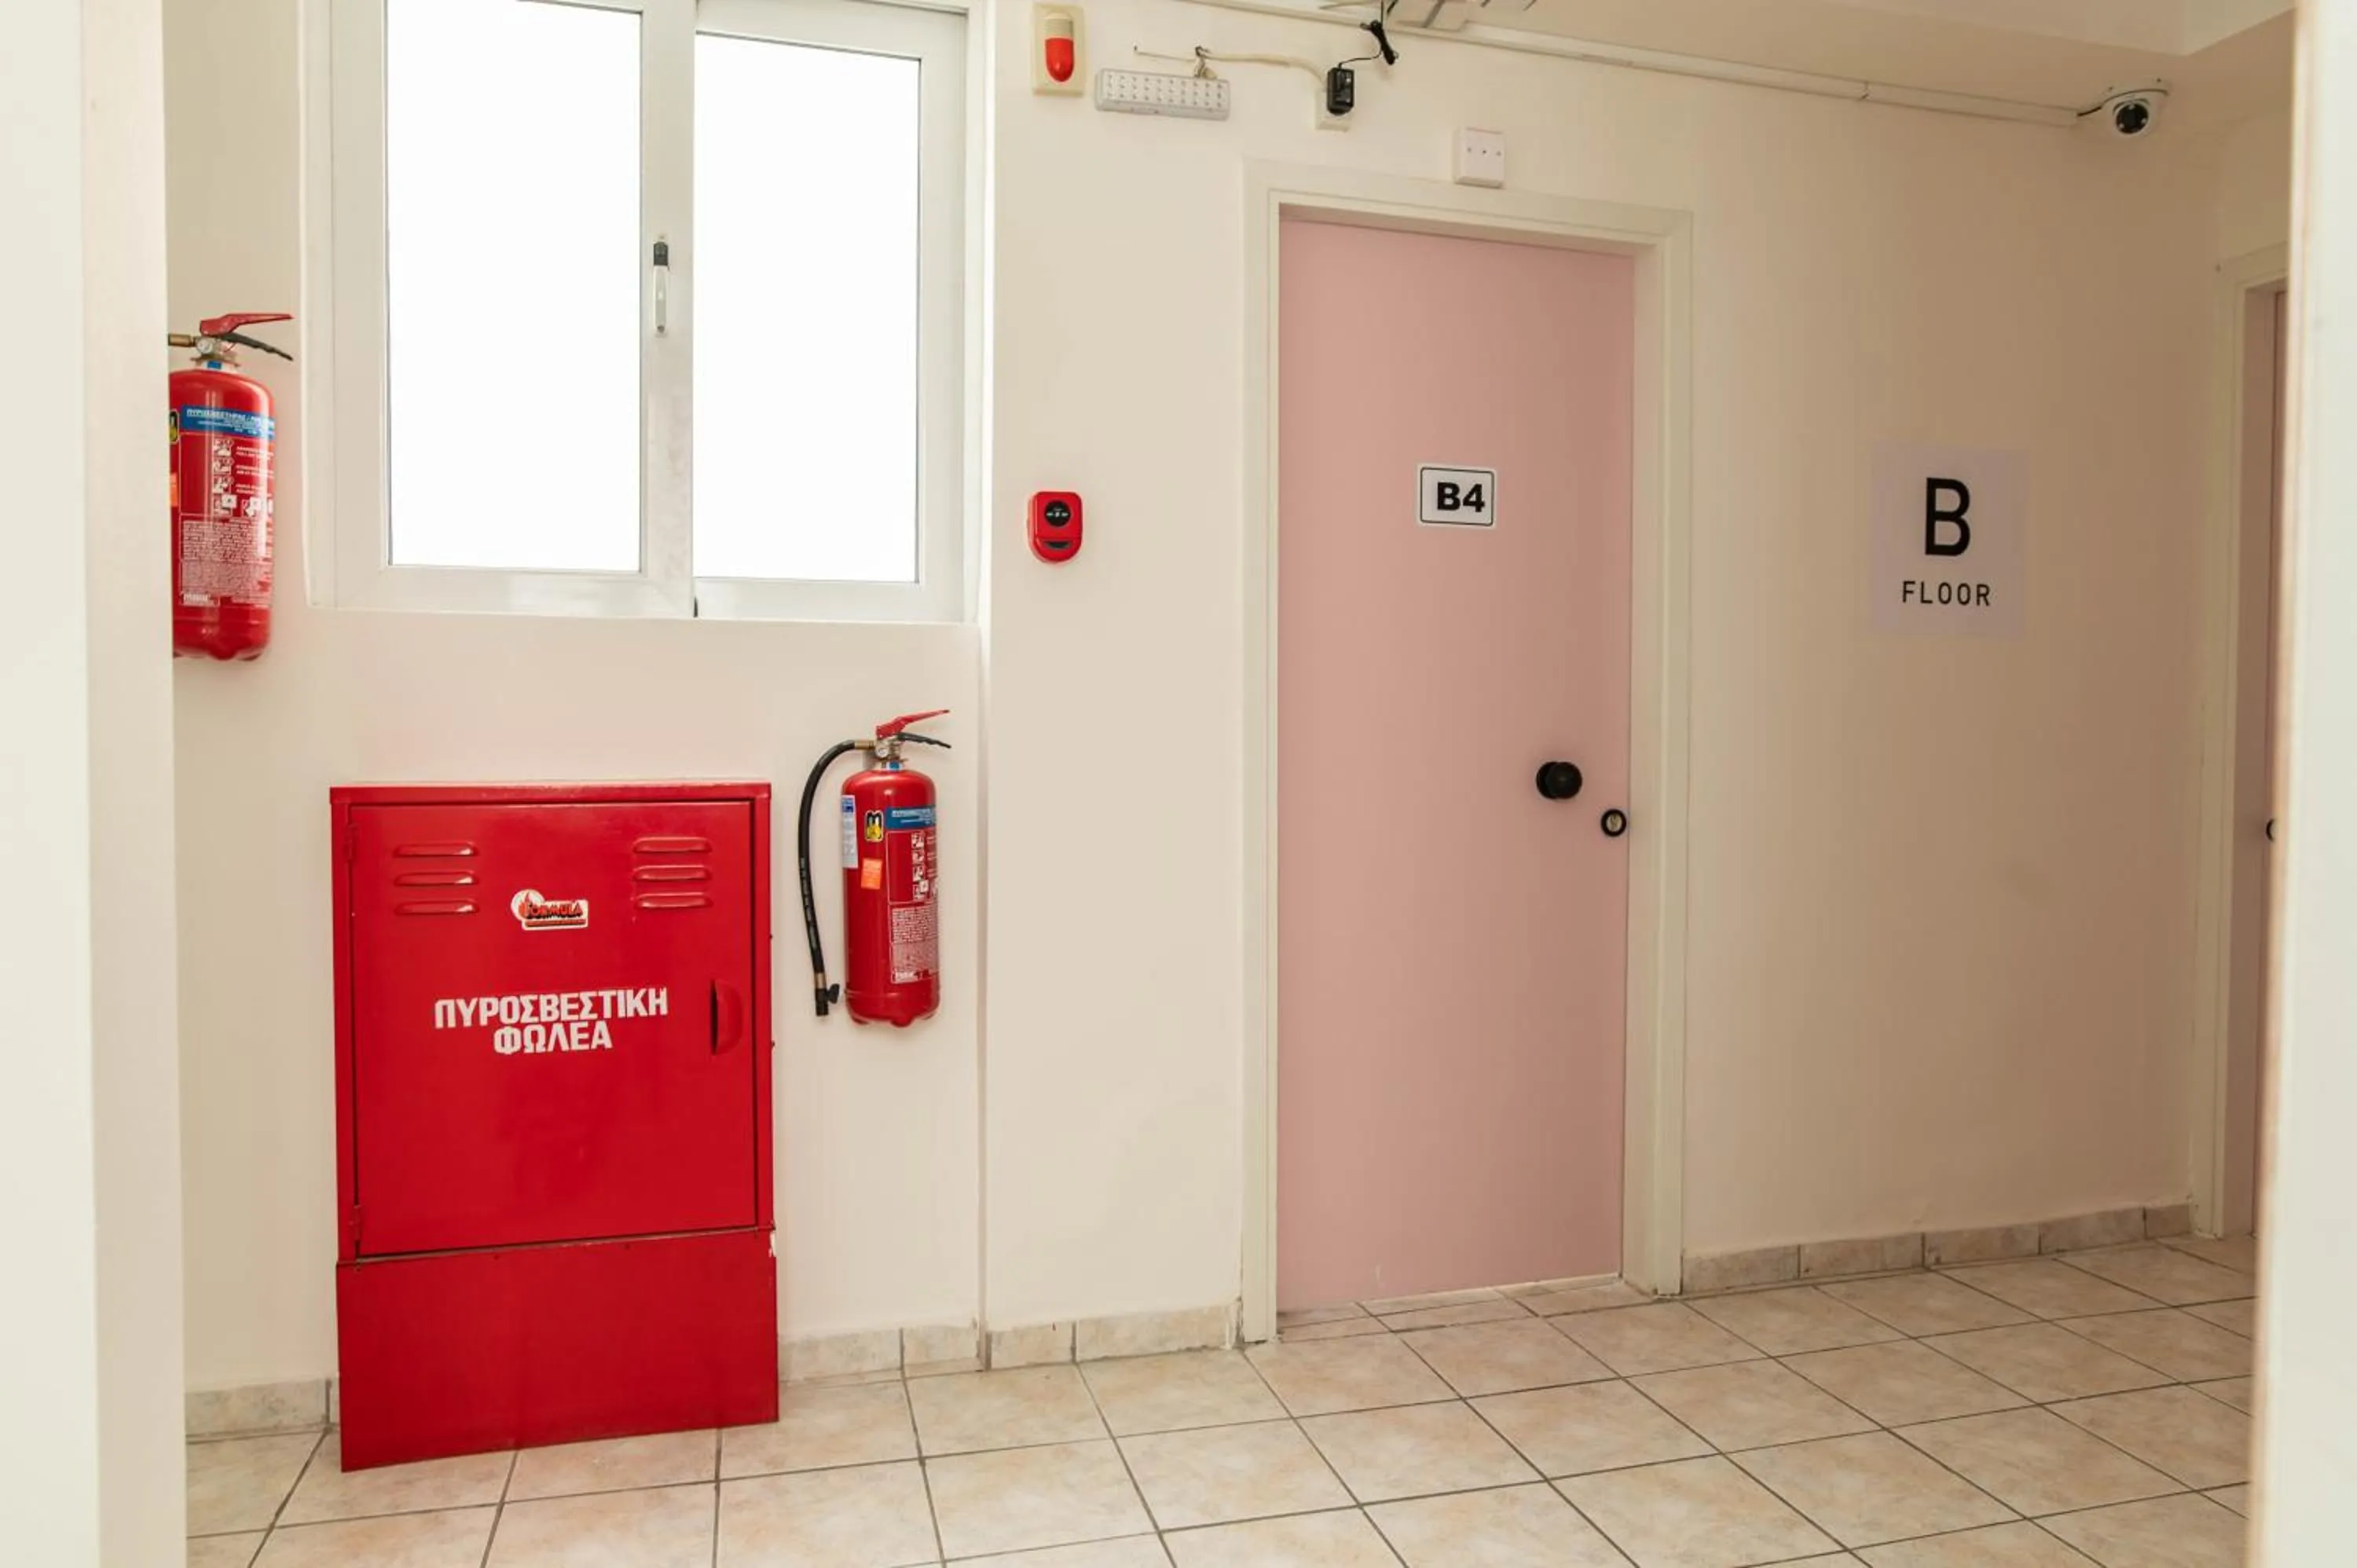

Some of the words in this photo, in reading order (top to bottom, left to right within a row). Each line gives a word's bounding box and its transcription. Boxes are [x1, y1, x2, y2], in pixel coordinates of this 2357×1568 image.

[1437, 482, 1485, 513] B4
[1925, 477, 1971, 557] B
[1901, 580, 1991, 607] FLOOR
[434, 987, 668, 1028] ΠΥΡΟΣΒΕΣΤΙΚΗ
[493, 1020, 613, 1055] ΦΩΛΕΑ
